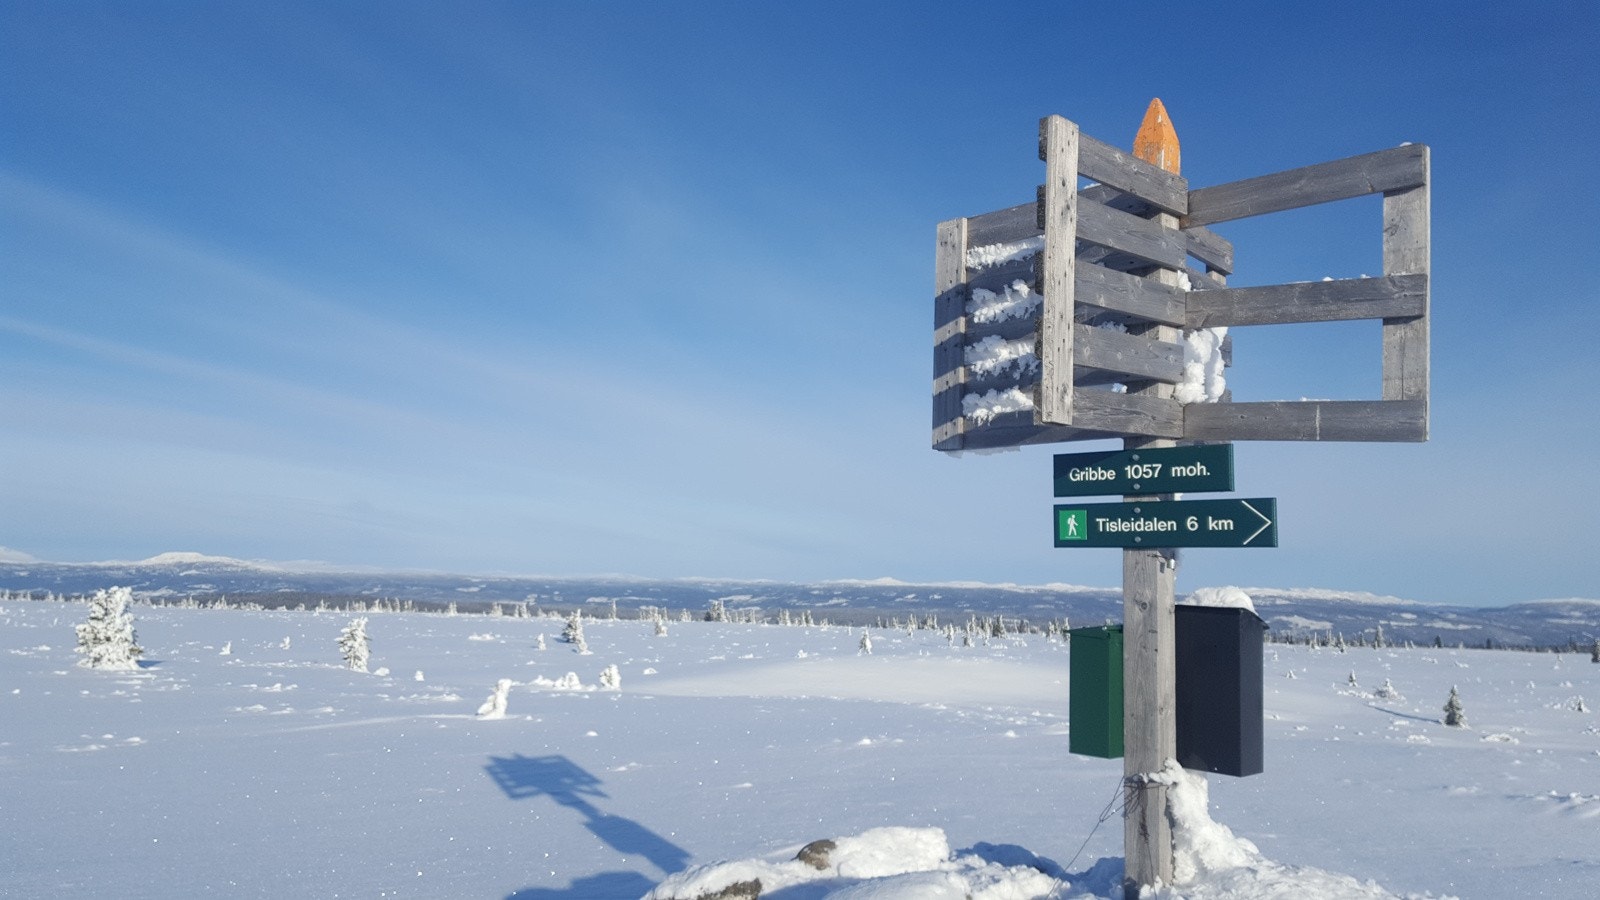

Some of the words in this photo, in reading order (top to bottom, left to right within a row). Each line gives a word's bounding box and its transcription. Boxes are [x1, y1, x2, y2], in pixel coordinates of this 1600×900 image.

[1069, 466, 1116, 482] Gribbe
[1124, 463, 1163, 479] 1057
[1171, 461, 1211, 477] moh.
[1095, 517, 1177, 532] Tisleidalen
[1186, 516, 1199, 532] 6
[1208, 516, 1234, 531] km
